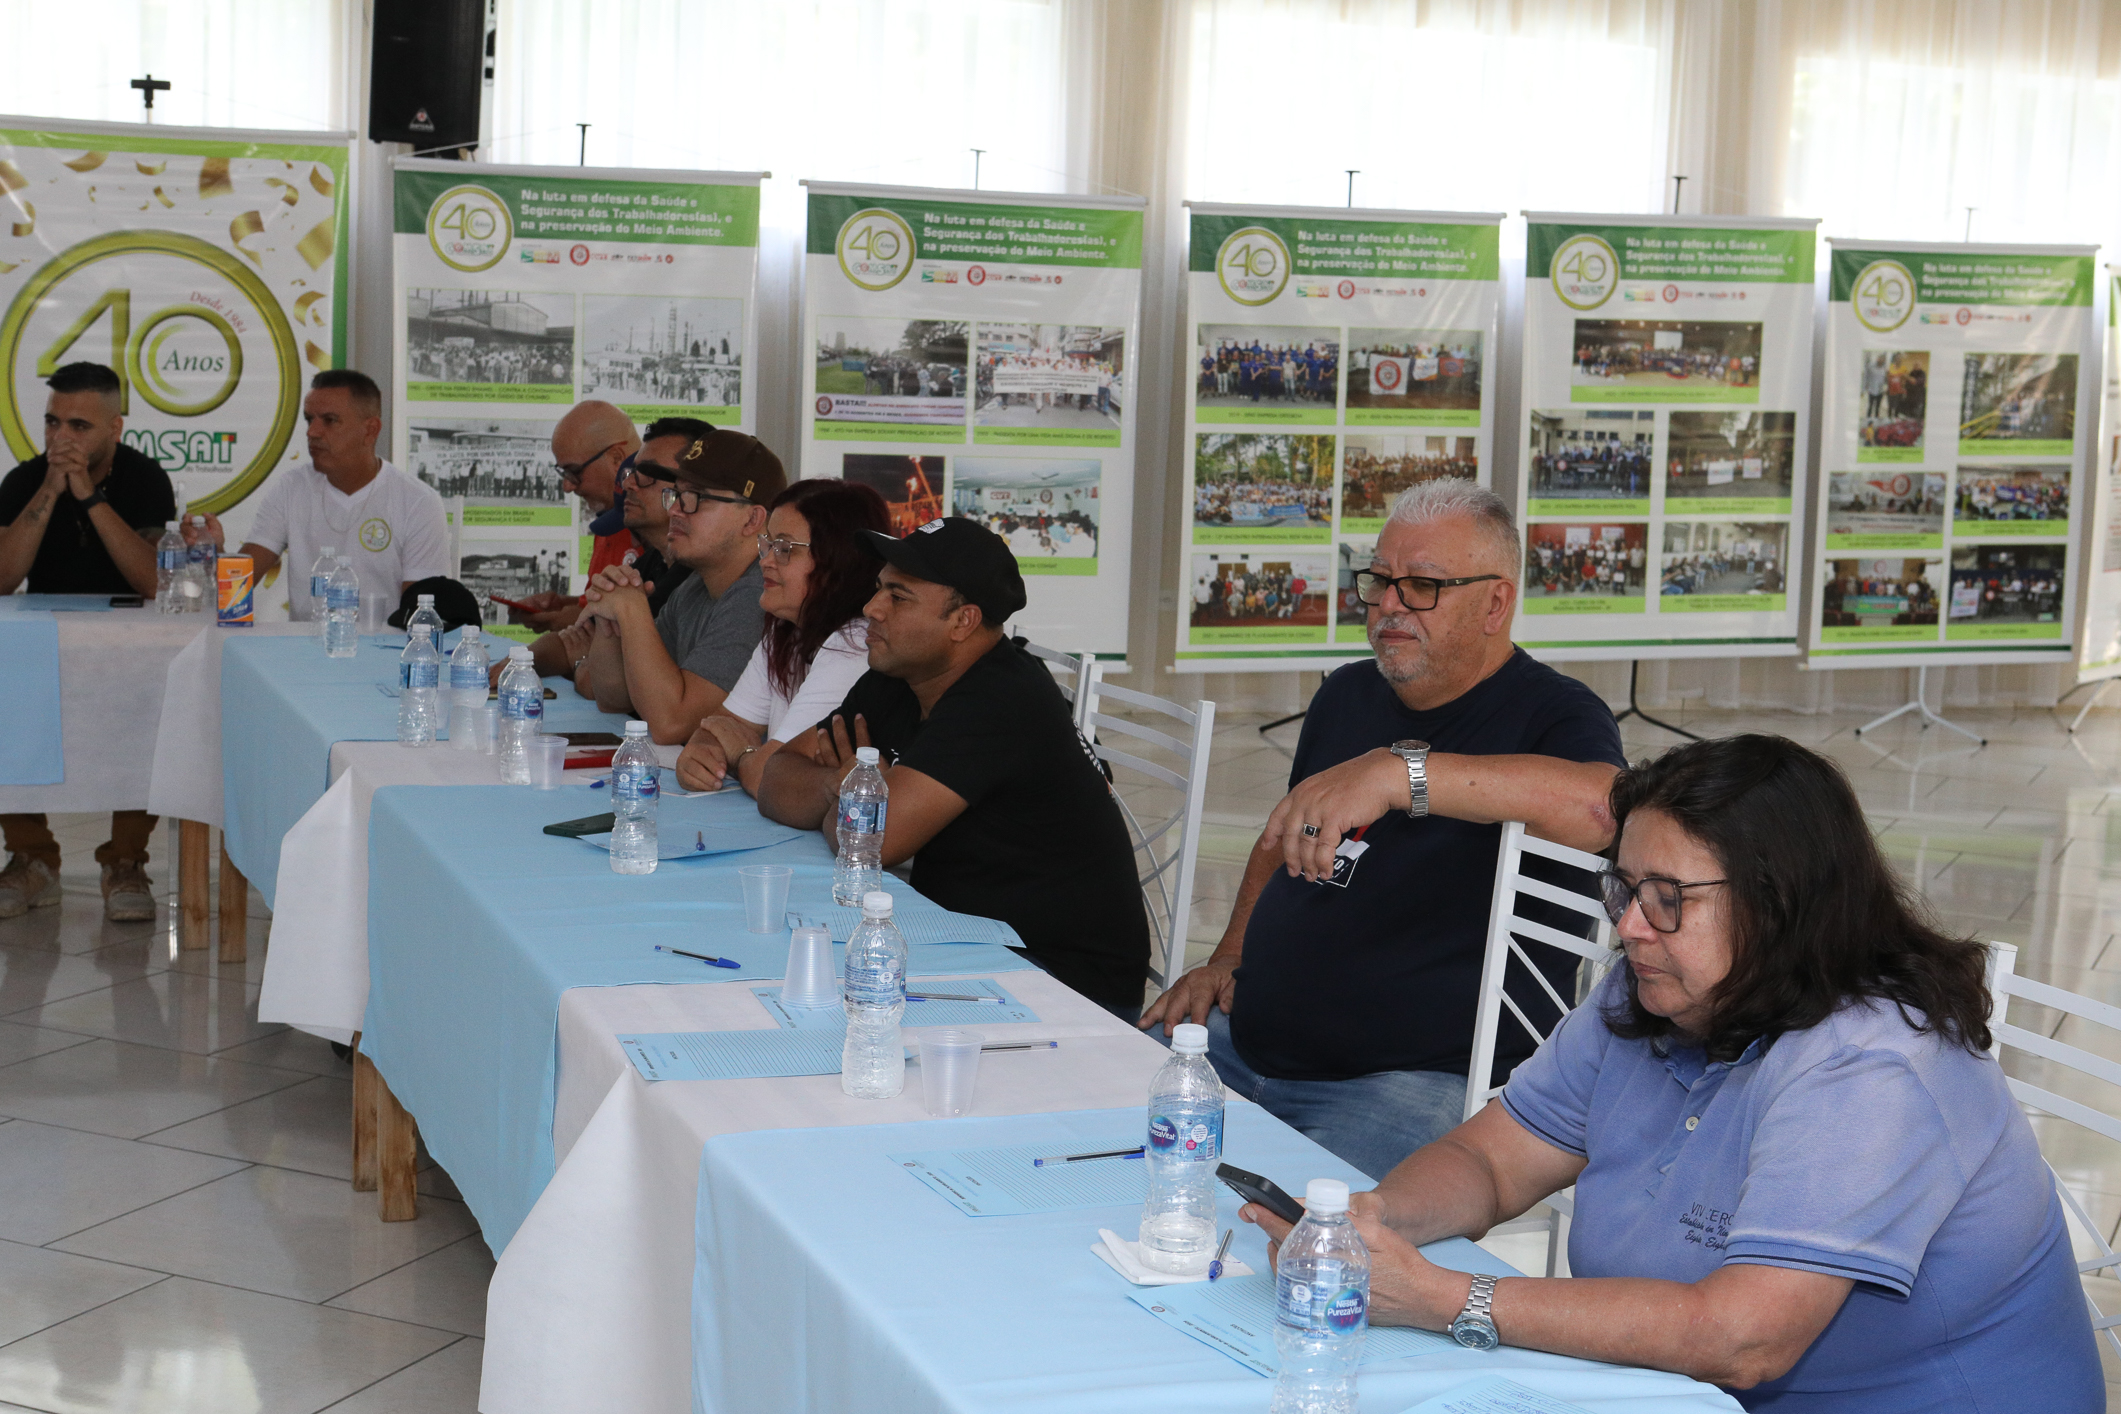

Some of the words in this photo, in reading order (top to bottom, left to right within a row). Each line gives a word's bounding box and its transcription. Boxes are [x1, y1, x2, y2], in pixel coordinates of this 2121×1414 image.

[521, 189, 539, 200] Na
[543, 190, 567, 202] luta
[570, 194, 588, 203] em
[591, 193, 630, 204] defesa
[633, 194, 648, 205] da
[651, 195, 687, 207] Saúde
[690, 199, 697, 207] e
[441, 203, 496, 240] 40
[520, 204, 584, 219] Segurança
[588, 207, 609, 218] dos
[725, 215, 732, 223] e
[924, 213, 940, 224] Na
[943, 214, 966, 225] luta
[969, 217, 985, 226] em
[988, 216, 1024, 228] defesa
[1027, 219, 1040, 229] da
[1043, 219, 1076, 231] Saúde
[1078, 222, 1086, 231] e
[520, 221, 536, 230] na
[539, 221, 612, 235] preservação
[616, 223, 630, 233] do
[633, 223, 663, 235] Meio
[666, 224, 724, 237] Ambiente.
[923, 227, 982, 241] Segurança
[985, 230, 1004, 240] dos
[1110, 237, 1116, 246] e
[1298, 230, 1313, 241] Na
[1316, 232, 1337, 242] luta
[1340, 234, 1355, 242] em
[1357, 233, 1391, 243] defesa
[1393, 234, 1405, 244] da
[1441, 237, 1448, 245] e
[849, 225, 900, 261] 40
[923, 242, 937, 252] na
[940, 243, 1007, 256] preservação
[1010, 246, 1024, 256] do
[1026, 246, 1054, 257] Meio
[1056, 247, 1109, 260] Ambiente.
[1297, 244, 1350, 257] Segurança
[1354, 247, 1372, 256] dos
[1228, 244, 1276, 277] 40
[1297, 259, 1310, 267] na
[1312, 260, 1375, 271] preservação
[1377, 261, 1390, 270] do
[1393, 260, 1417, 270] Meio
[1562, 251, 1606, 282] 40
[1862, 276, 1904, 306] 40
[190, 290, 224, 313] Desde
[224, 307, 247, 335] 1984
[36, 288, 243, 417] 40
[162, 349, 225, 373] Anos
[1327, 1304, 1363, 1317] PurezaVital
[1336, 1298, 1360, 1308] Nestlé
